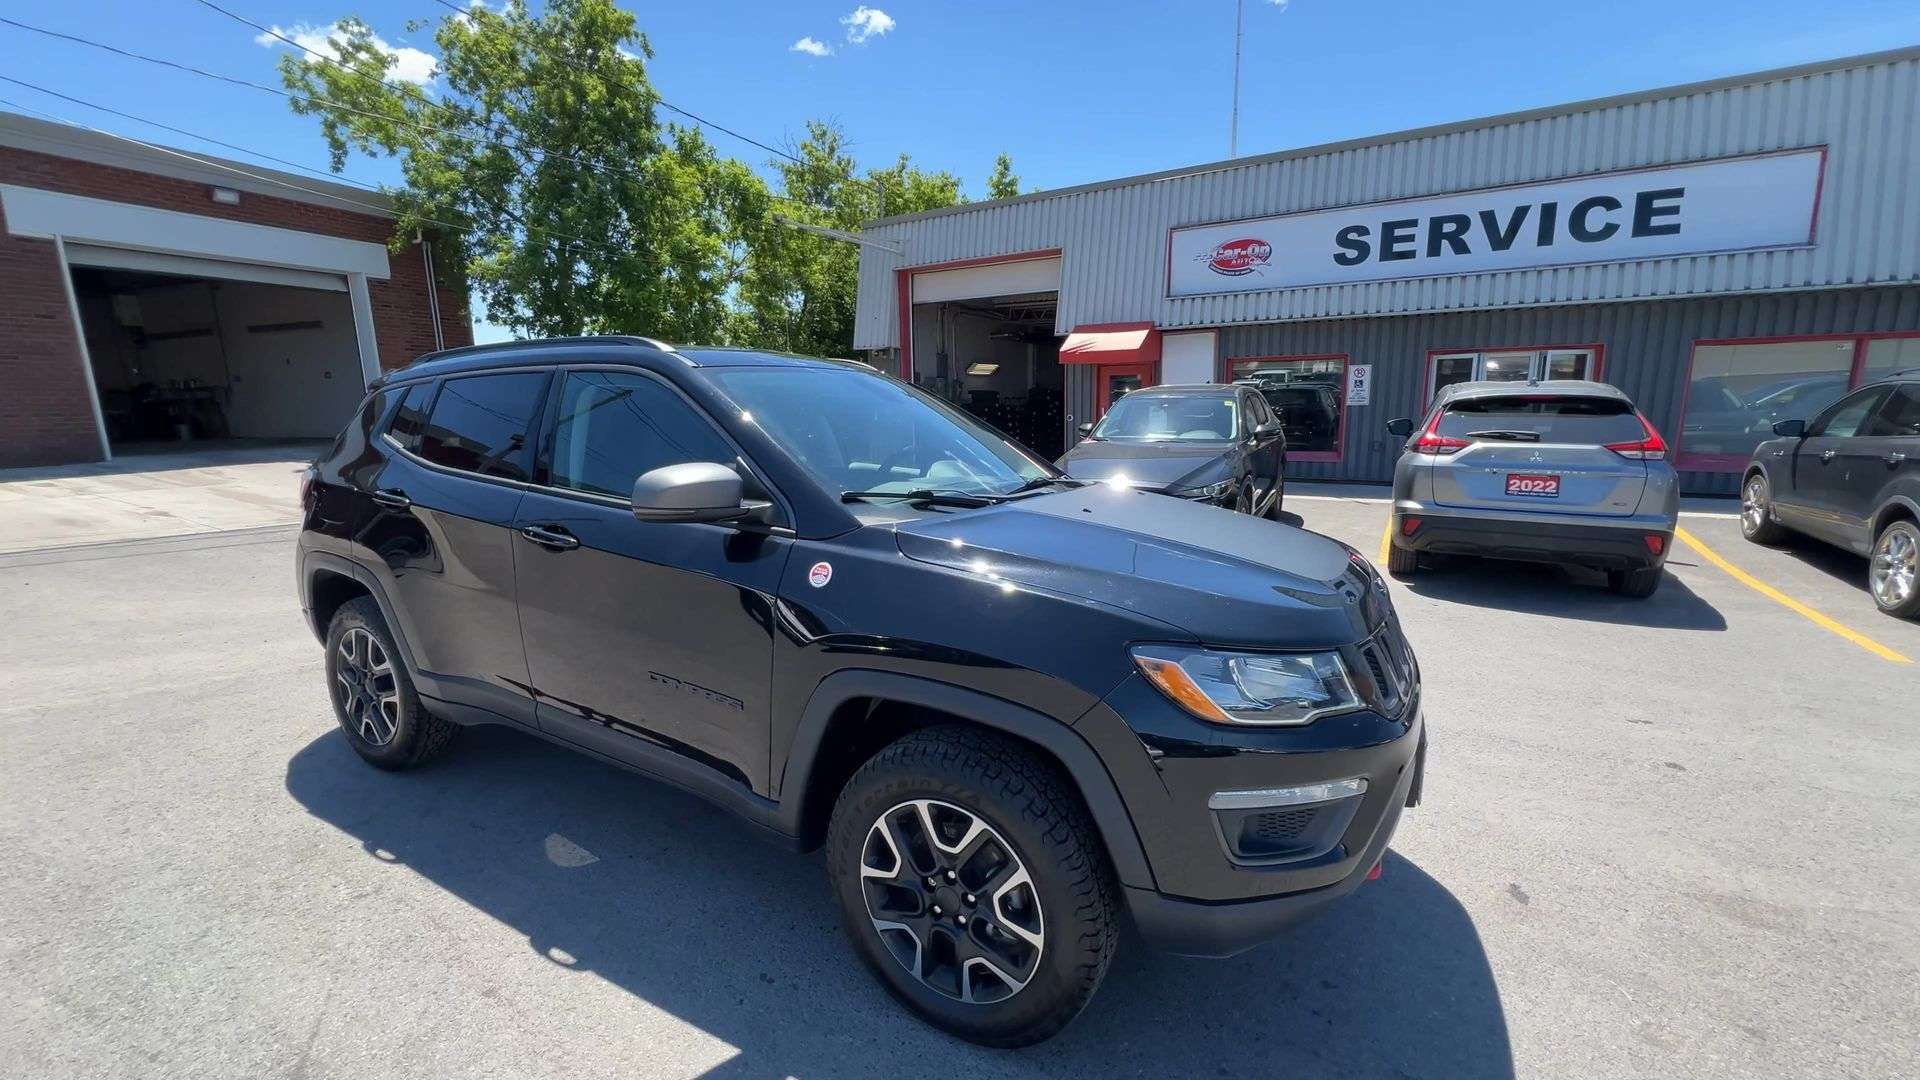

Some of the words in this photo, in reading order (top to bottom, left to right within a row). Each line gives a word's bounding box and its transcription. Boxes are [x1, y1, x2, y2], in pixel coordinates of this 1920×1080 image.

[1333, 187, 1685, 266] SERVICE
[1213, 243, 1270, 260] Car-On
[1508, 479, 1557, 493] 2022
